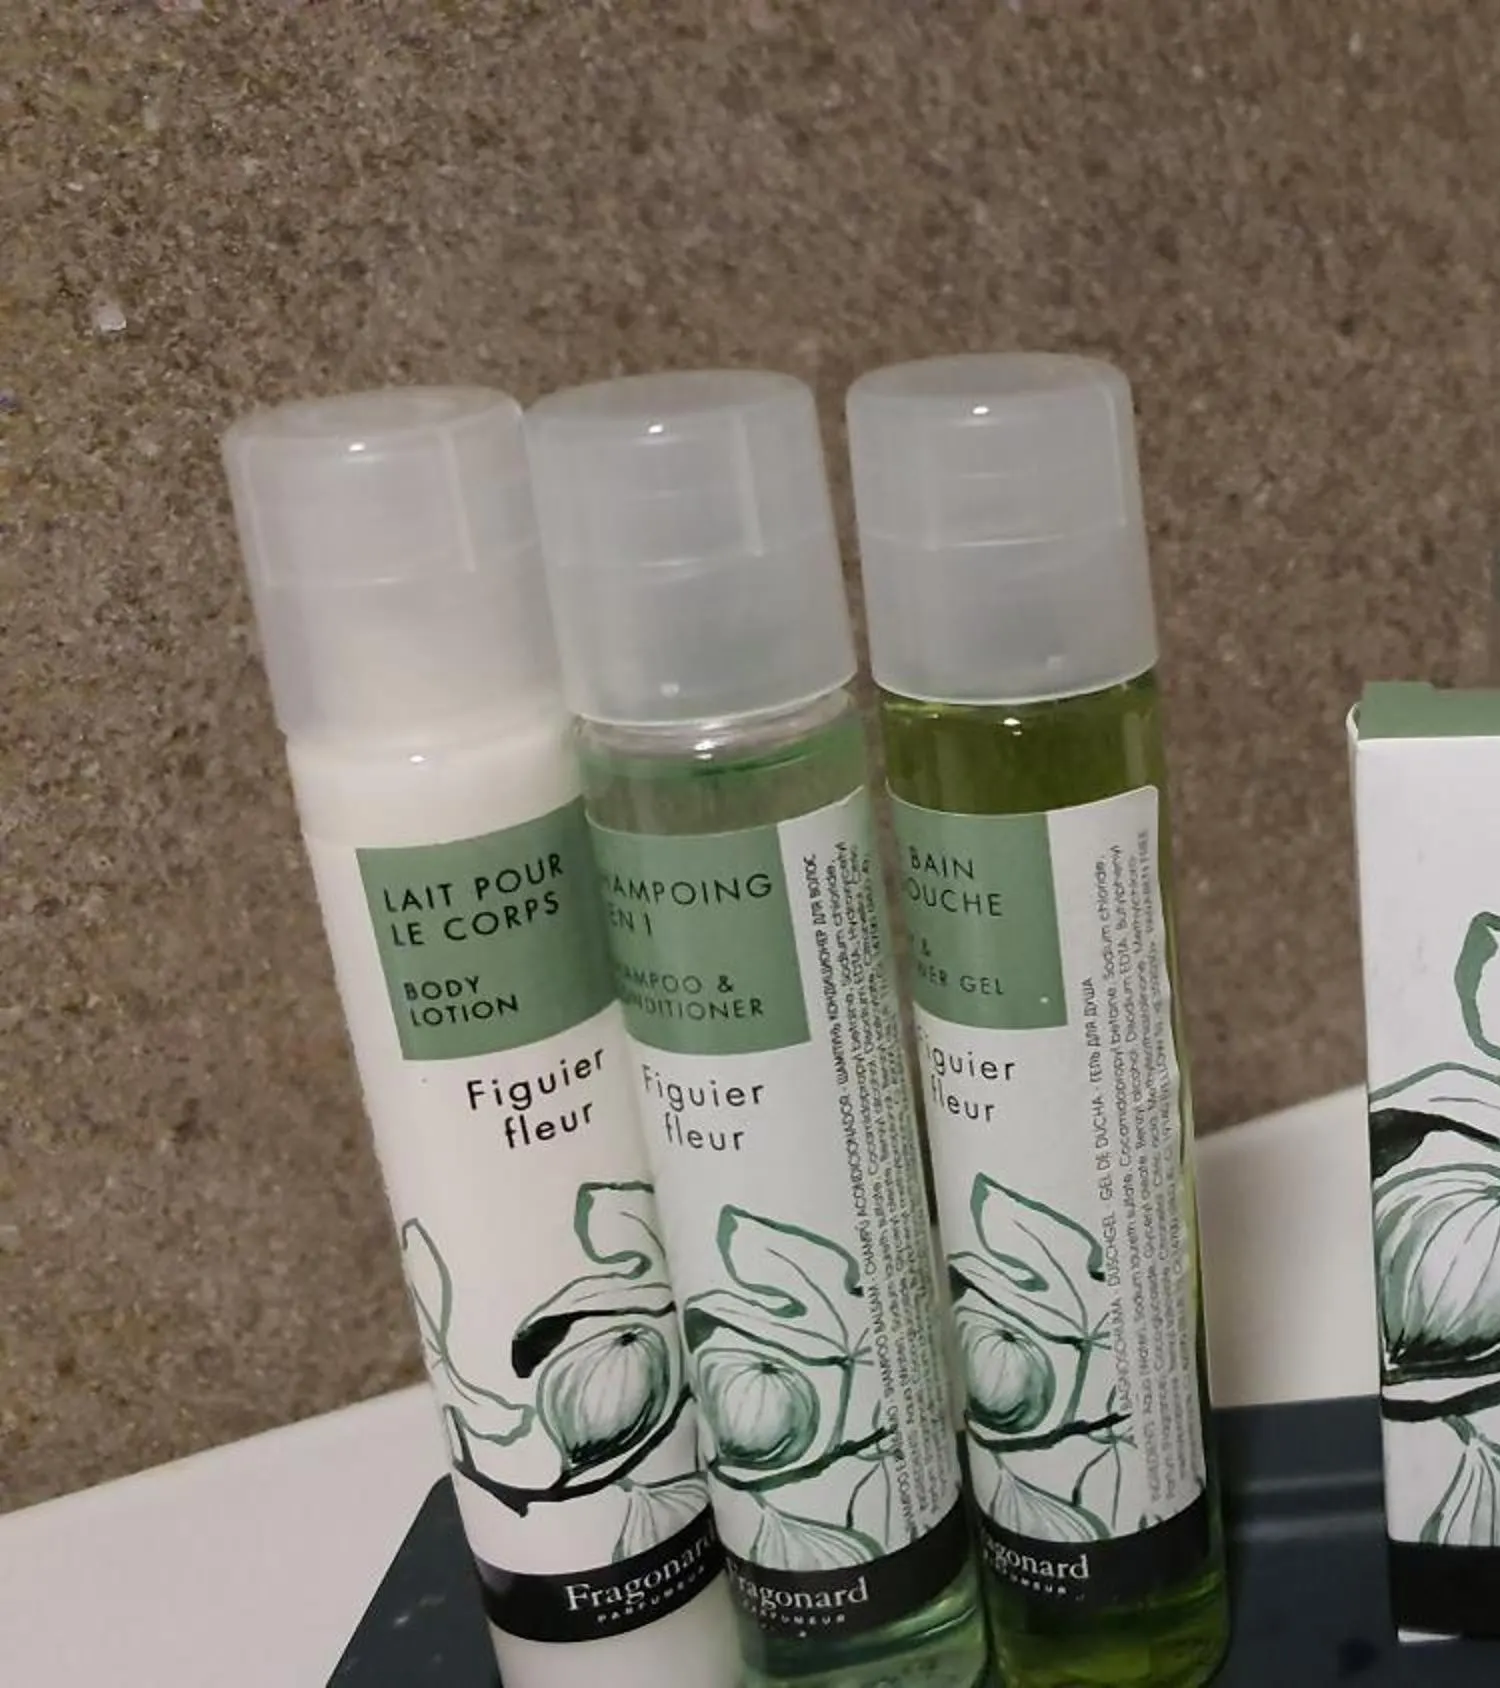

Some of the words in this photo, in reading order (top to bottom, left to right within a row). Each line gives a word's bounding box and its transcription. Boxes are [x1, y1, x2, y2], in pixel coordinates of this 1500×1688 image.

[908, 845, 974, 880] BAIN
[384, 882, 452, 913] LAIT
[475, 853, 565, 900] POUR
[609, 874, 772, 907] AMPOING
[902, 877, 1003, 917] OUCHE
[391, 922, 425, 947] LE
[444, 890, 560, 942] CORPS
[404, 975, 480, 1001] BODY
[624, 966, 702, 995] AMPOO
[717, 975, 734, 993] &
[959, 974, 1004, 996] GEL
[411, 994, 519, 1027] LOTION
[466, 1047, 605, 1112] Figuier
[641, 1063, 765, 1113] Figuier
[504, 1101, 594, 1149] fleur
[665, 1111, 745, 1152] fleur
